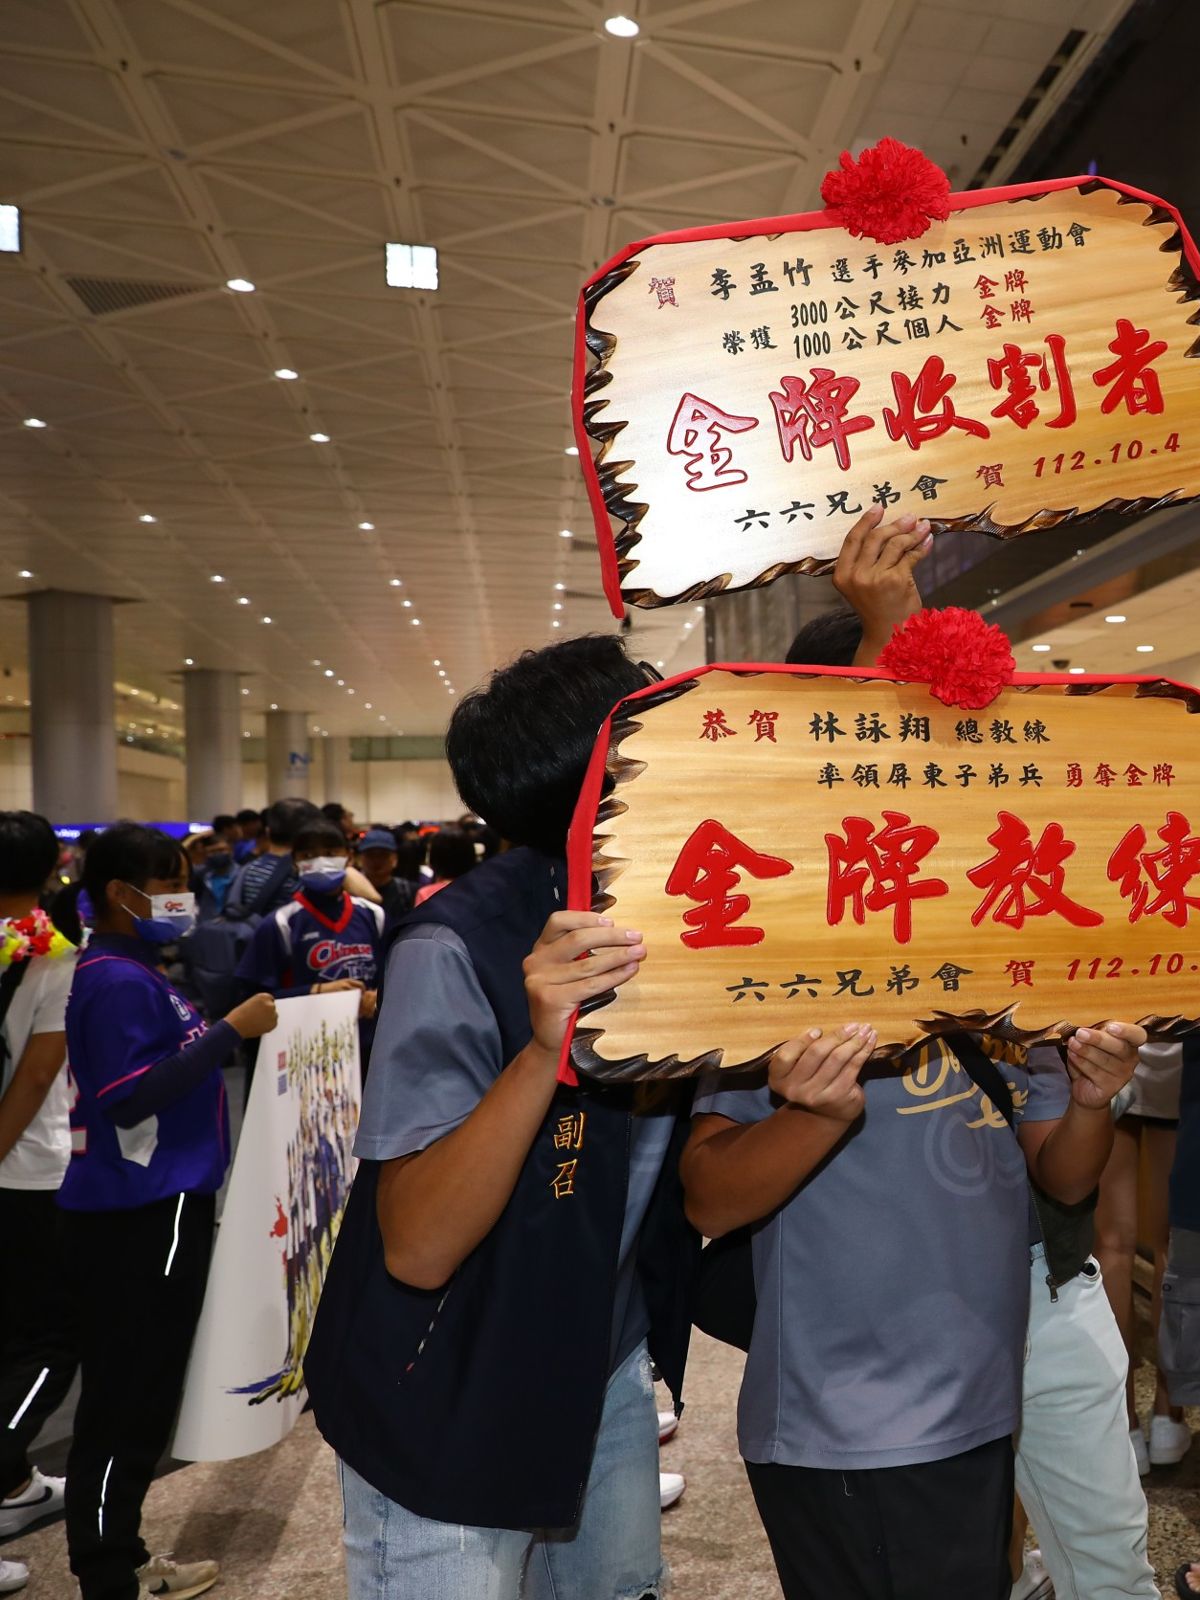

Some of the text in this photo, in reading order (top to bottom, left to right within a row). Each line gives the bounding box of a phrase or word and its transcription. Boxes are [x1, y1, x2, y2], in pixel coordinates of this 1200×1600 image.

[648, 276, 679, 309] 賀
[710, 258, 813, 301] 李孟竹
[973, 268, 1029, 300] 金牌
[722, 325, 778, 356] 榮獲
[979, 298, 1036, 330] 金牌
[666, 318, 1169, 493] 金牌收割者
[734, 432, 1181, 533] 六六兄弟會 賀 112.10.4
[699, 709, 1051, 744] 恭賀 林詠翔 總教練
[817, 761, 1176, 789] 率領屏東子弟兵 勇奪金牌
[725, 962, 974, 1002] 六六兄弟會
[1004, 959, 1037, 987] 賀
[549, 1112, 584, 1200] 副召
